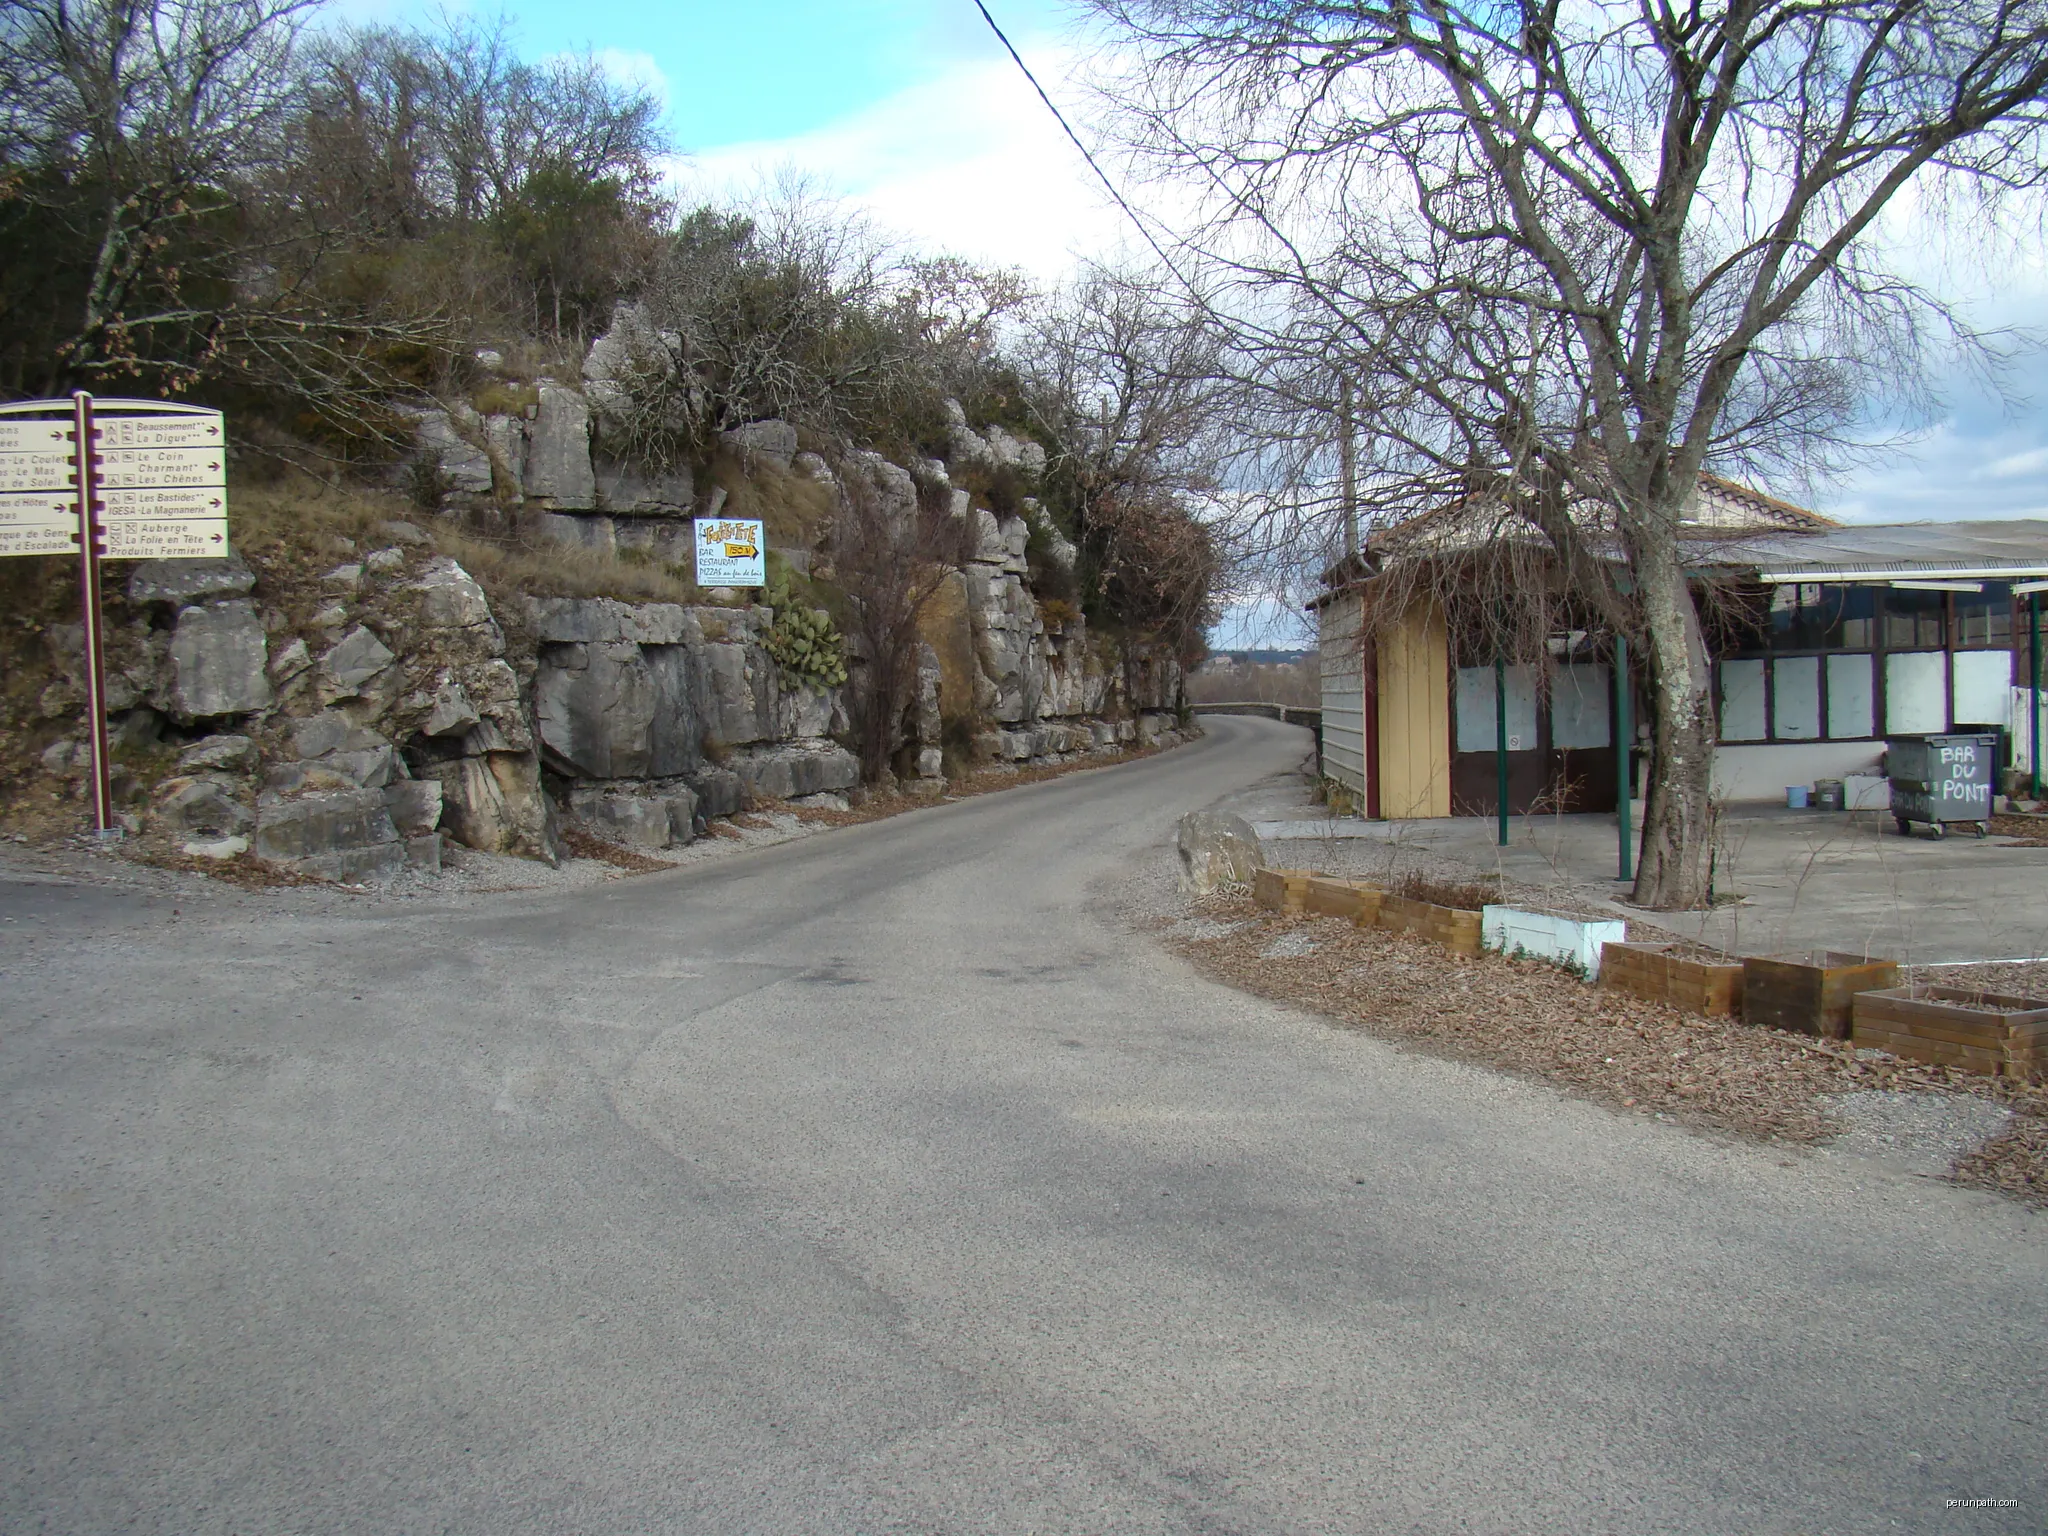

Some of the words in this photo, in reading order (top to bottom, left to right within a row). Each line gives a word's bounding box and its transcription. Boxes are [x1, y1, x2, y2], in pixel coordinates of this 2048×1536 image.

[136, 422, 196, 431] Beaussement
[137, 434, 149, 443] La
[155, 433, 187, 444] Digue
[31, 454, 66, 464] Coulet
[138, 452, 150, 461] Le
[158, 451, 184, 461] Coin
[34, 467, 56, 475] Mas
[138, 463, 193, 472] Charmant
[12, 477, 24, 487] de
[30, 477, 61, 487] Soleil
[138, 474, 157, 484] Les
[163, 474, 204, 484] Chênes
[139, 493, 155, 502] Les
[157, 493, 196, 502] Bastides
[108, 506, 136, 516] IGESA
[154, 505, 207, 516] Magnanerie
[26, 529, 38, 538] de
[43, 529, 69, 538] Gens
[141, 524, 188, 534] Auberge
[126, 536, 137, 545] La
[140, 535, 162, 544] Folie
[183, 534, 204, 544] Tête
[110, 547, 155, 556] Produits
[160, 546, 207, 555] Fermiers
[699, 548, 714, 556] BAR
[730, 546, 743, 555] 150
[699, 558, 739, 566] RESTAURANT
[699, 567, 722, 576] PIZZAS
[1940, 746, 1975, 764] BAR
[1952, 764, 1976, 779] DU
[1942, 780, 1991, 803] PONT
